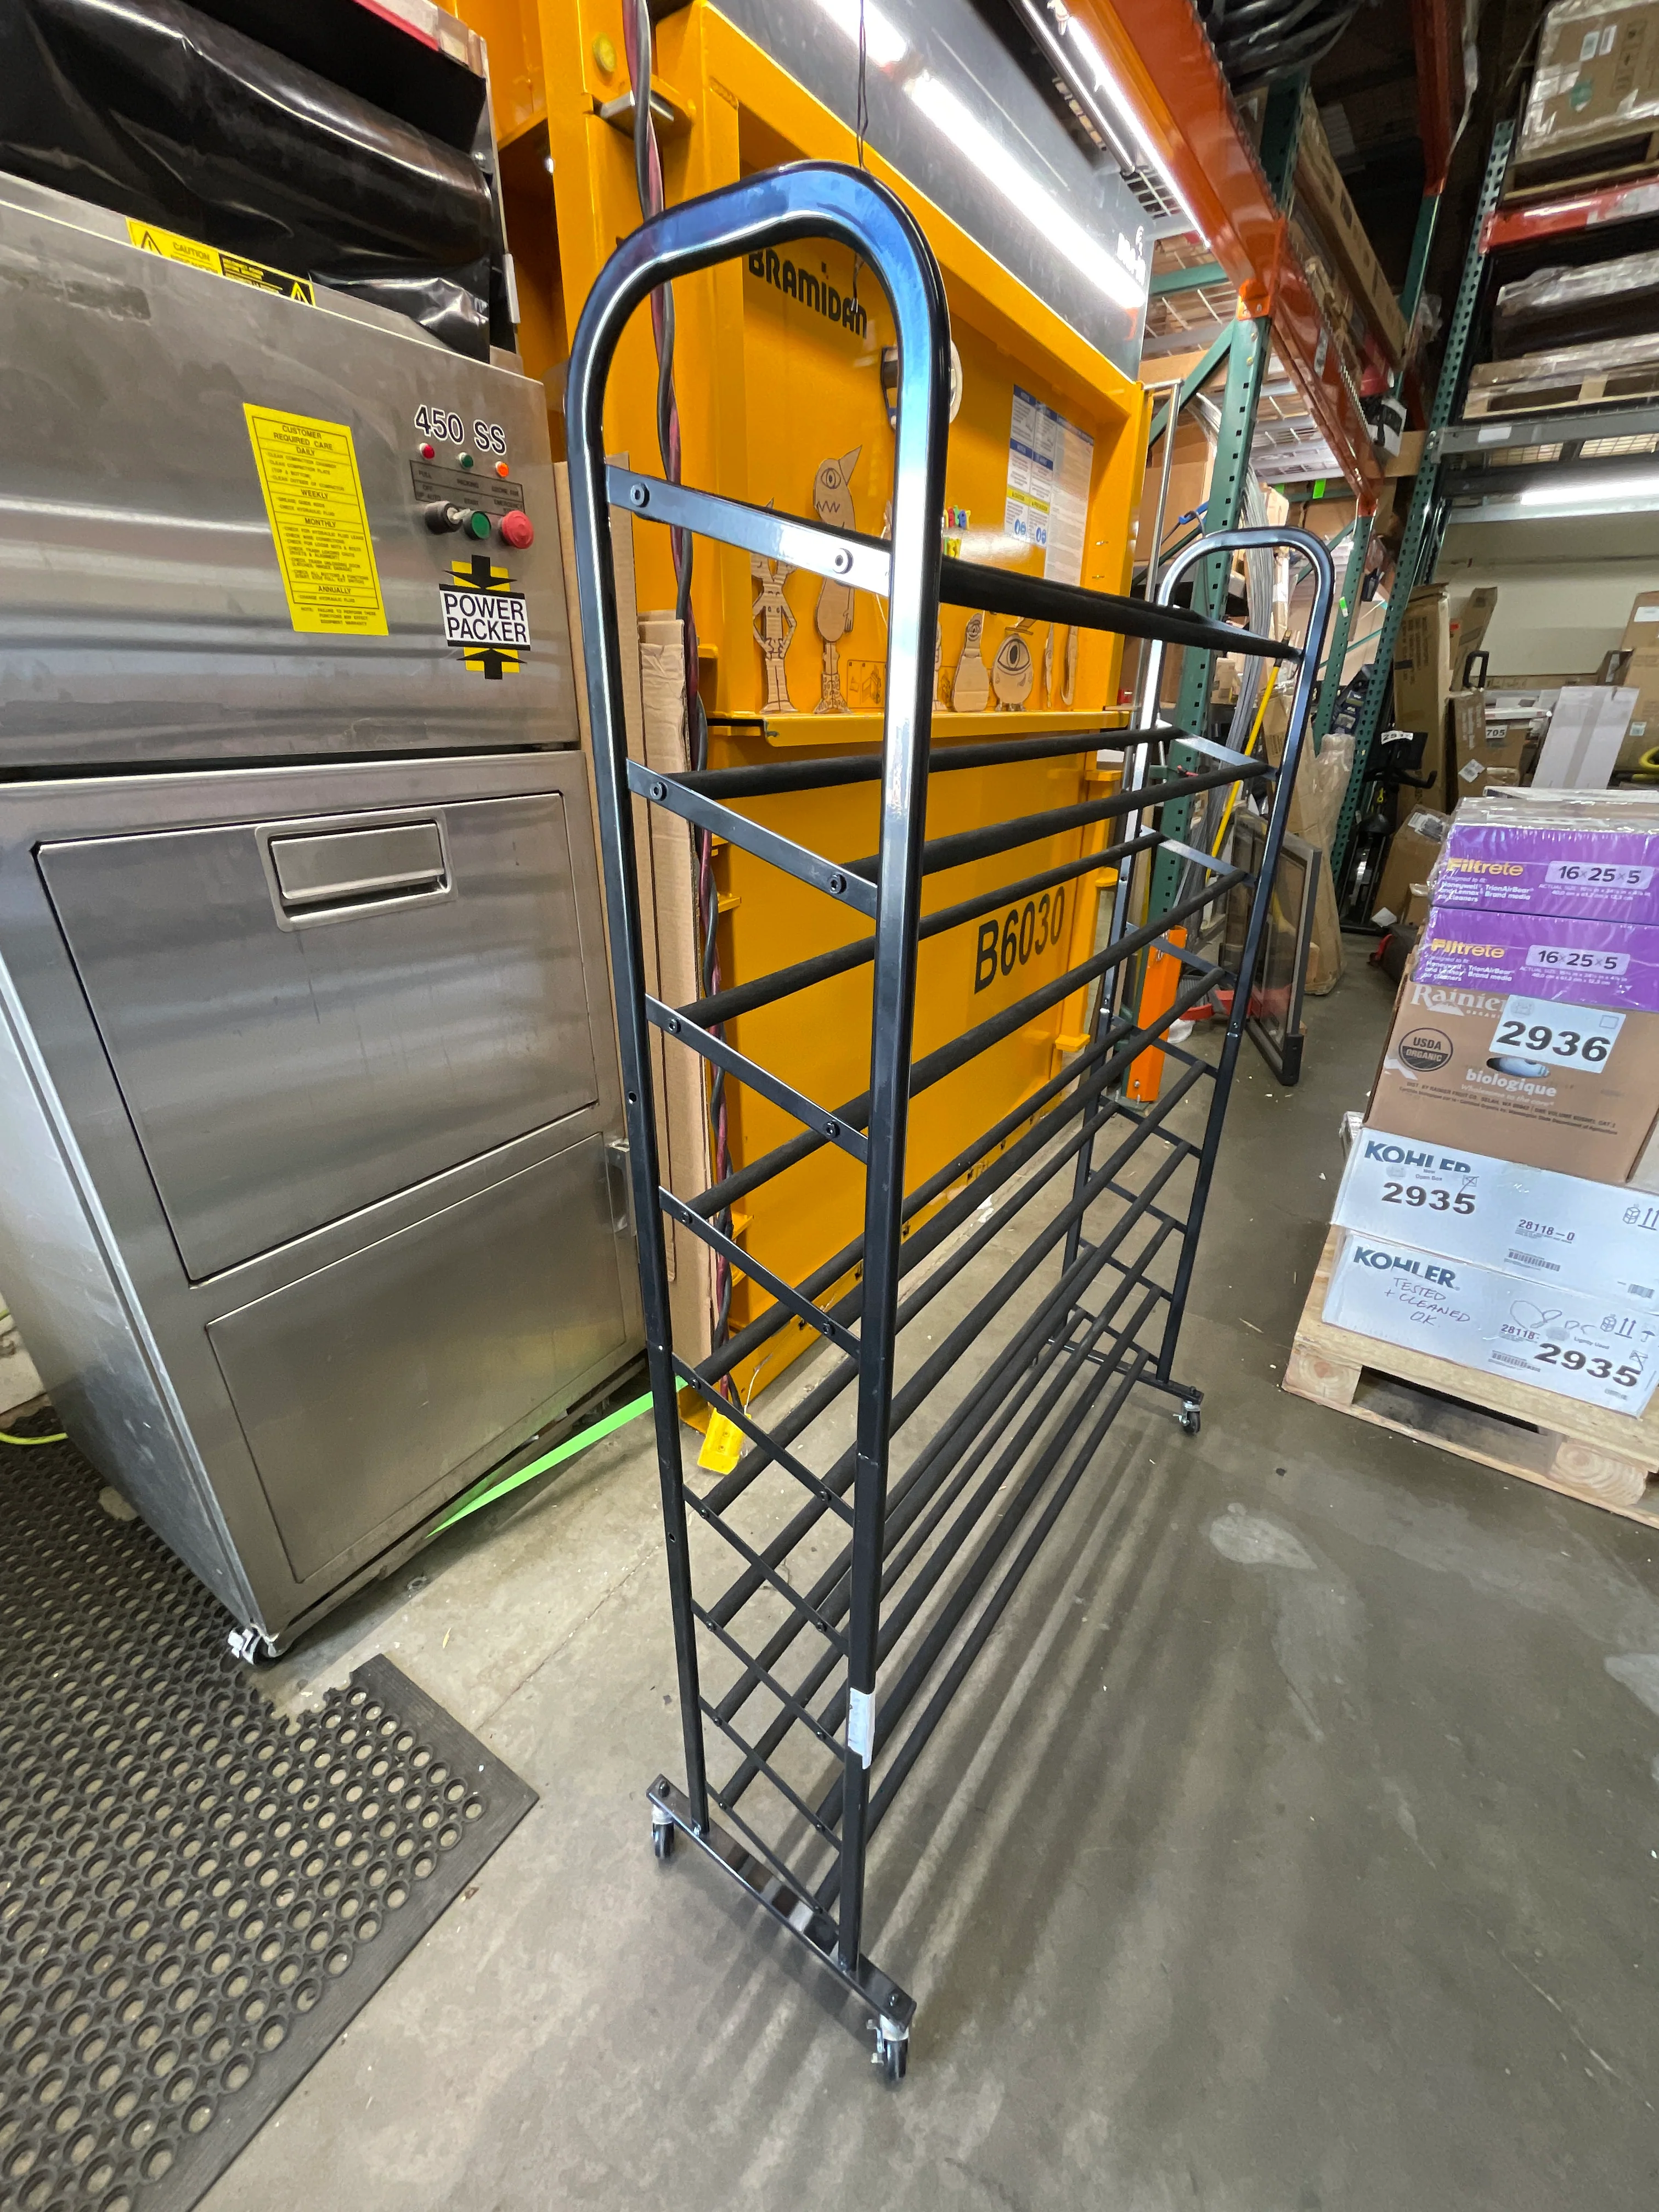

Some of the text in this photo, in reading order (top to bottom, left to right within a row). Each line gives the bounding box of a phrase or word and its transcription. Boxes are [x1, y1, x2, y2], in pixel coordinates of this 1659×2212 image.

[172, 241, 210, 261] CAUTION
[273, 432, 334, 450] REQUIRED CARE
[282, 425, 322, 439] CUSTOMER
[414, 404, 507, 456] 450 SS
[296, 447, 315, 456] DAILY
[301, 489, 329, 499] WEEKLY
[305, 518, 336, 528] MONTHLY
[318, 586, 351, 594] ANNUALLY
[444, 592, 524, 621] POWER
[447, 617, 527, 643] PACKER
[1446, 857, 1524, 876] Filtrete
[1558, 866, 1581, 879] 16
[1588, 867, 1616, 882] 25
[1627, 870, 1641, 884] 5
[974, 886, 1065, 995] B6030
[1430, 938, 1504, 958] Filtrete
[1538, 950, 1559, 964] 16
[1566, 953, 1594, 967] 25
[1604, 956, 1618, 969] 5
[1413, 1036, 1442, 1051] USDA
[1496, 1020, 1611, 1062] 2936
[1406, 1048, 1443, 1062] ORGANIC
[1466, 1069, 1557, 1097] biologique
[1381, 1182, 1477, 1215] 2935
[1353, 1246, 1457, 1290] KOHLER
[1393, 1277, 1447, 1301] TESTED
[1399, 1293, 1471, 1322] CLEANED
[1534, 1343, 1641, 1387] 2935
